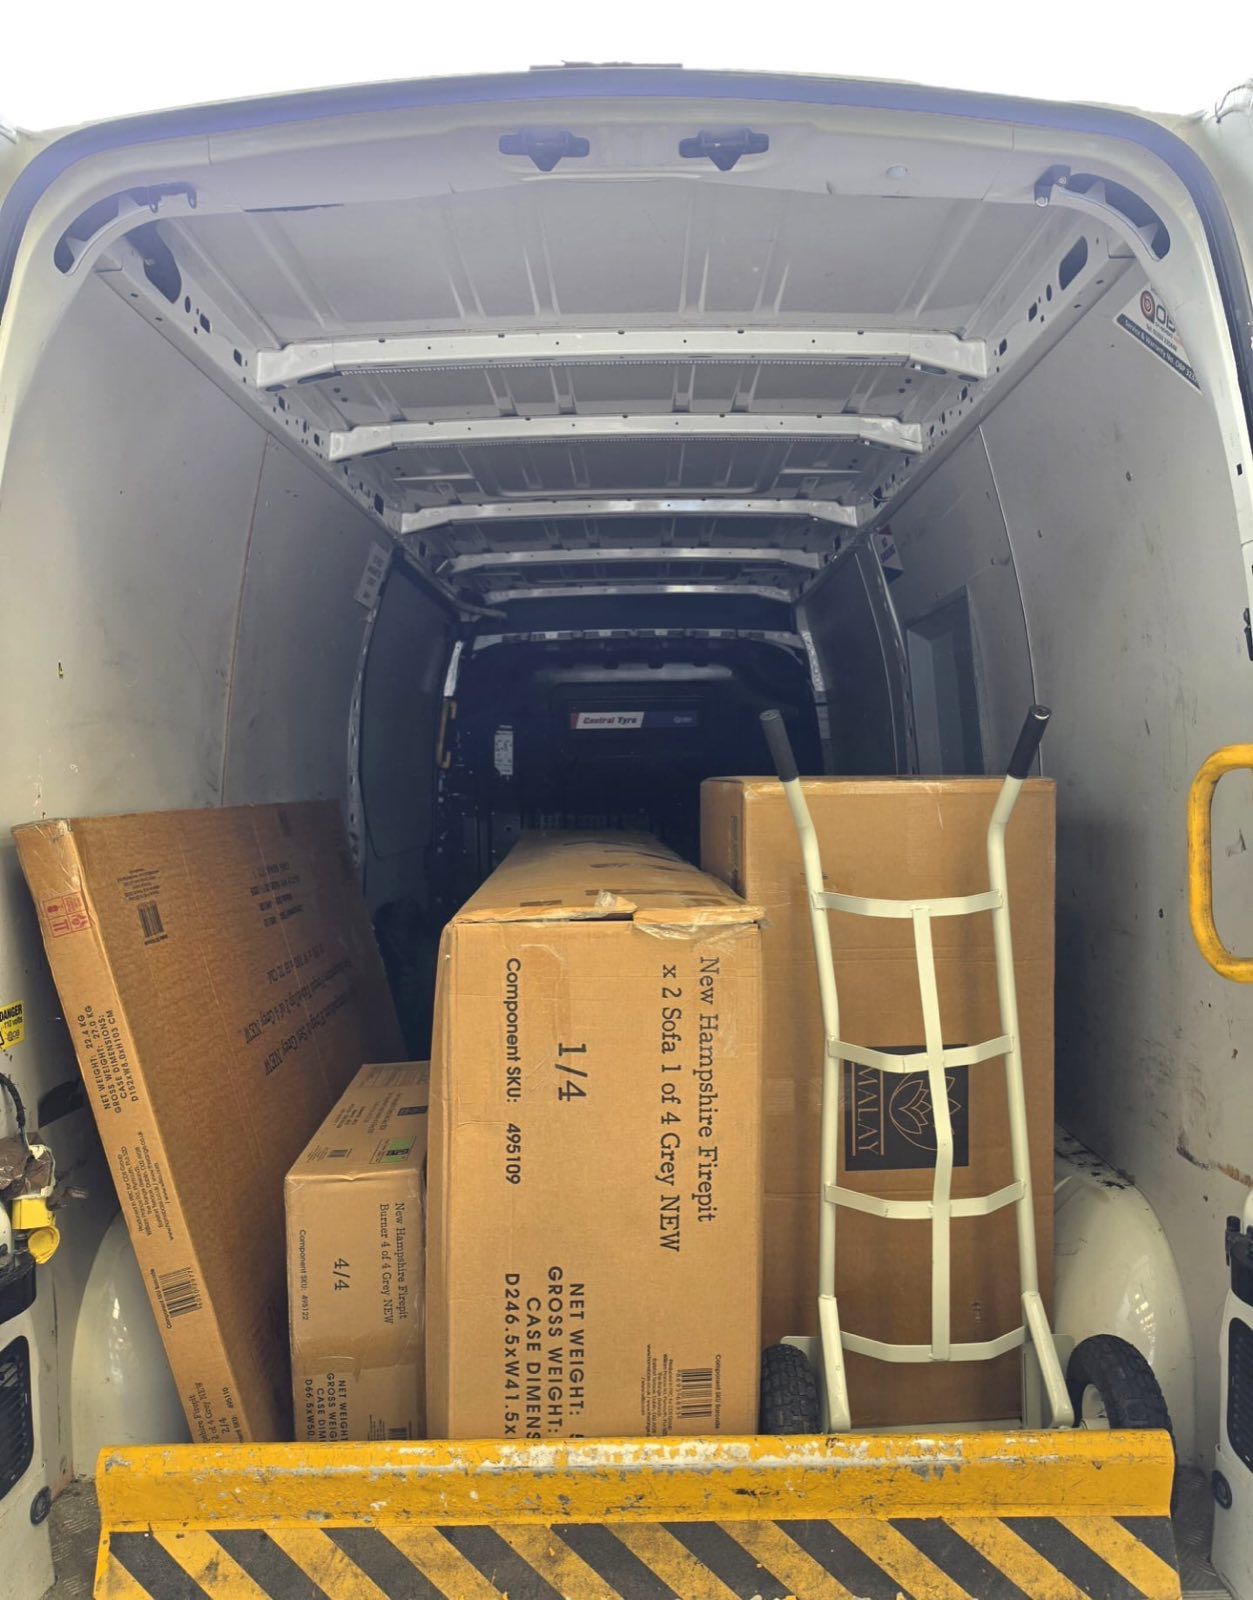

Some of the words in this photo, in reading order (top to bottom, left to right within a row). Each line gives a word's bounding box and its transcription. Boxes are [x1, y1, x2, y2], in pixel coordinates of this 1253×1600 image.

[661, 964, 677, 979] x
[698, 957, 720, 1004] New
[661, 987, 681, 999] 2
[0, 1004, 22, 1022] DANGER
[77, 1014, 87, 1028] KG
[84, 1005, 94, 1018] KG
[106, 1009, 116, 1025] CM
[504, 958, 522, 1062] Component
[82, 1029, 93, 1049] 22.4
[89, 1020, 100, 1040] 27.0
[97, 1014, 120, 1073] DIMENSIONS:
[661, 1007, 682, 1053] Sofa
[89, 1054, 106, 1092] WEIGHT:
[96, 1044, 112, 1081] WEIGHT:
[556, 1041, 588, 1102] 1/4
[661, 1065, 681, 1074] 1
[692, 1013, 719, 1138] Hampshire
[107, 1083, 122, 1114] GROSS
[115, 1076, 128, 1099] CASE
[505, 1066, 522, 1102] SKU:
[660, 1082, 682, 1105] of
[100, 1093, 111, 1110] NET
[858, 1068, 878, 1155] MALAY
[660, 1111, 681, 1126] 4
[505, 1123, 521, 1184] 495109
[655, 1132, 680, 1186] Grey
[695, 1146, 719, 1222] Firepit
[379, 1204, 390, 1238] Burner
[395, 1203, 406, 1224] New
[659, 1194, 680, 1253] NEW
[299, 1230, 307, 1273] Component
[381, 1250, 391, 1260] of
[395, 1228, 407, 1282] Hampshire
[300, 1275, 308, 1290] SKU:
[333, 1258, 350, 1291] 4/4
[379, 1272, 393, 1295] Grey
[383, 1299, 393, 1324] NEW
[395, 1286, 408, 1319] Firepit
[547, 1266, 563, 1337] GROSS
[569, 1283, 585, 1324] NET
[526, 1297, 542, 1352] CASE
[504, 1273, 520, 1439] D246.5xW41.5x
[569, 1330, 585, 1416] WEIGHT:
[188, 1394, 204, 1419] Firepit
[194, 1381, 207, 1401] NEW
[317, 1388, 325, 1414] CASE
[327, 1373, 335, 1407] GROSS
[548, 1347, 563, 1434] WEIGHT:
[218, 1416, 231, 1434] 2/4
